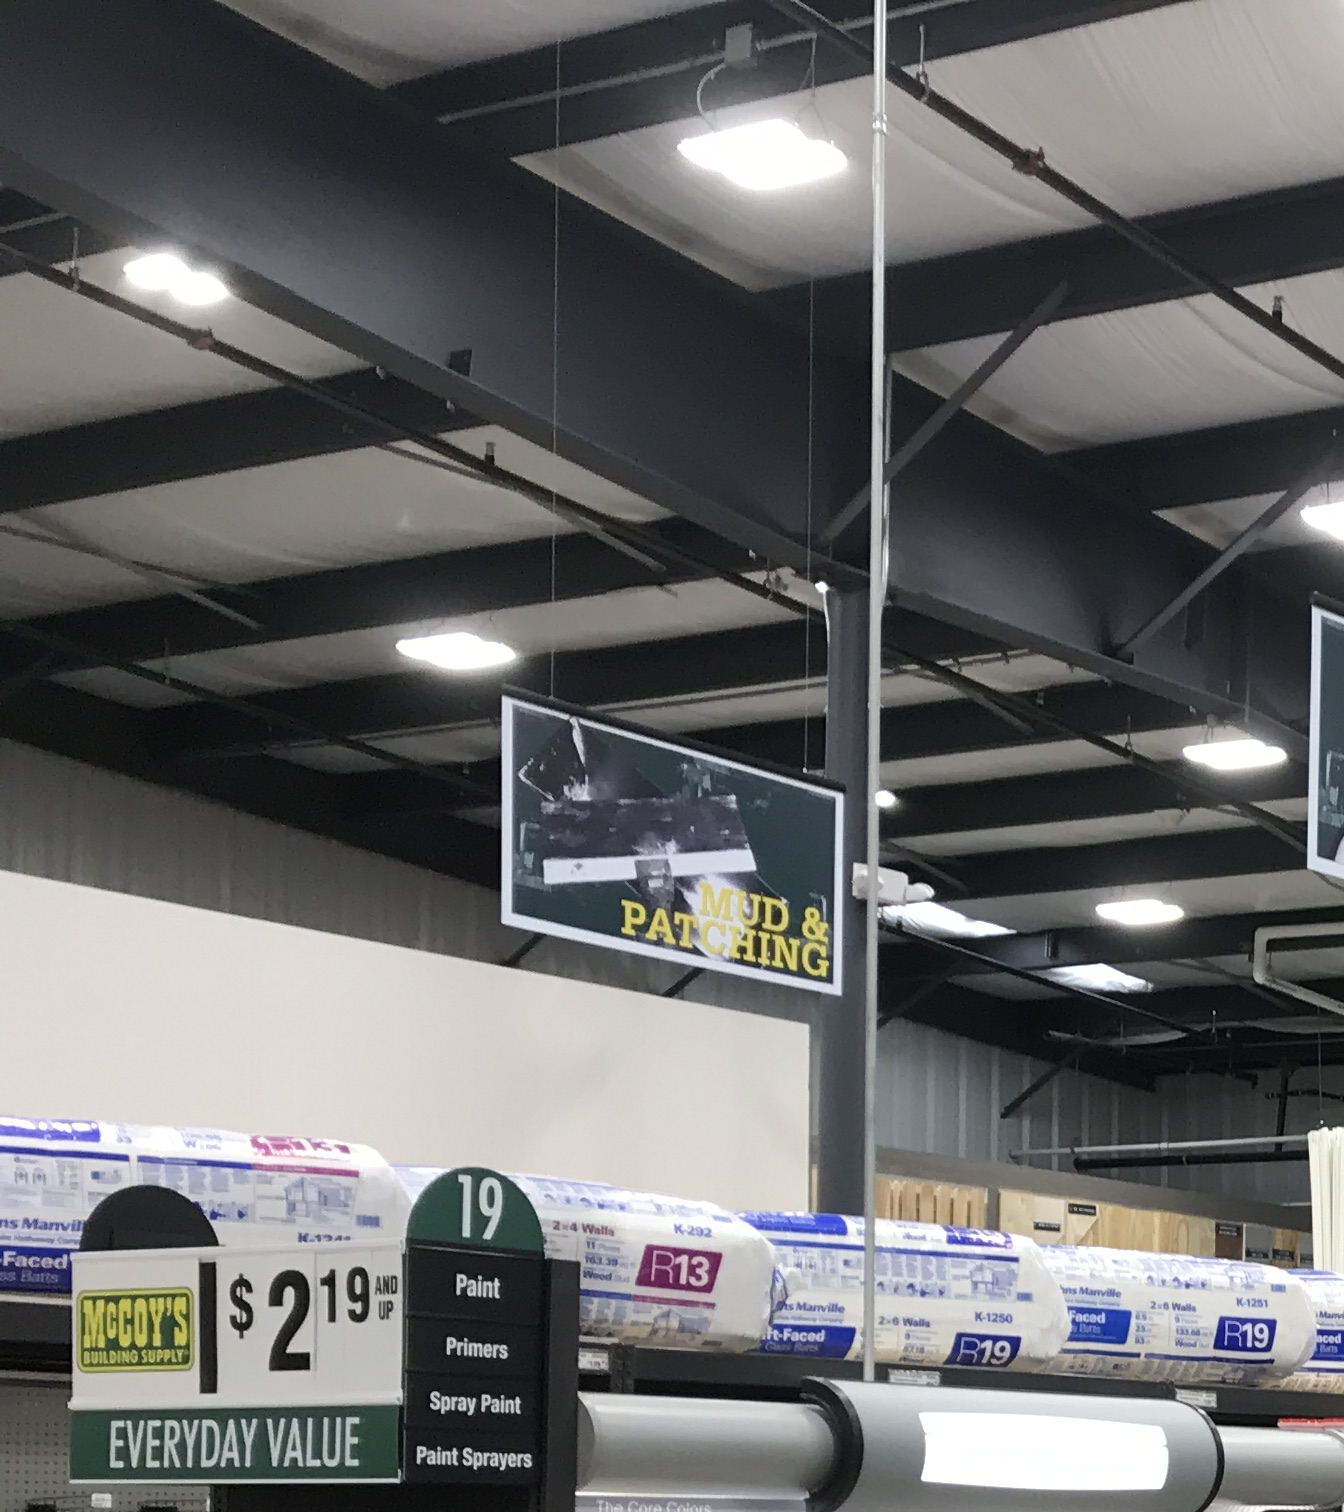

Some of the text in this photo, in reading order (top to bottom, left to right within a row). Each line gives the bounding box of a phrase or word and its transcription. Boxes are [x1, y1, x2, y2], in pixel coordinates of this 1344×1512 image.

[699, 881, 829, 942] MUD &
[621, 899, 829, 978] PATCHING
[458, 1174, 503, 1240] 19
[582, 1222, 615, 1237] Walls
[673, 1223, 713, 1238] K-292
[650, 1250, 710, 1287] R13
[375, 1275, 398, 1295] AND
[455, 1274, 501, 1300] Paint
[1079, 1286, 1122, 1299] Manville
[378, 1300, 394, 1320] UP
[797, 1302, 845, 1314] Manville
[975, 1311, 1013, 1324] K-1250
[1172, 1301, 1197, 1313] Walls
[902, 1317, 931, 1329] Walls
[1224, 1320, 1270, 1348] R19
[83, 1349, 185, 1365] BUILDING SUPPLY
[446, 1337, 508, 1359] Primers
[958, 1337, 1012, 1365] R19
[429, 1391, 521, 1416] Spray Paint
[109, 1416, 360, 1469] EVERYDAY VALUE
[416, 1446, 532, 1470] Paint Sprayers
